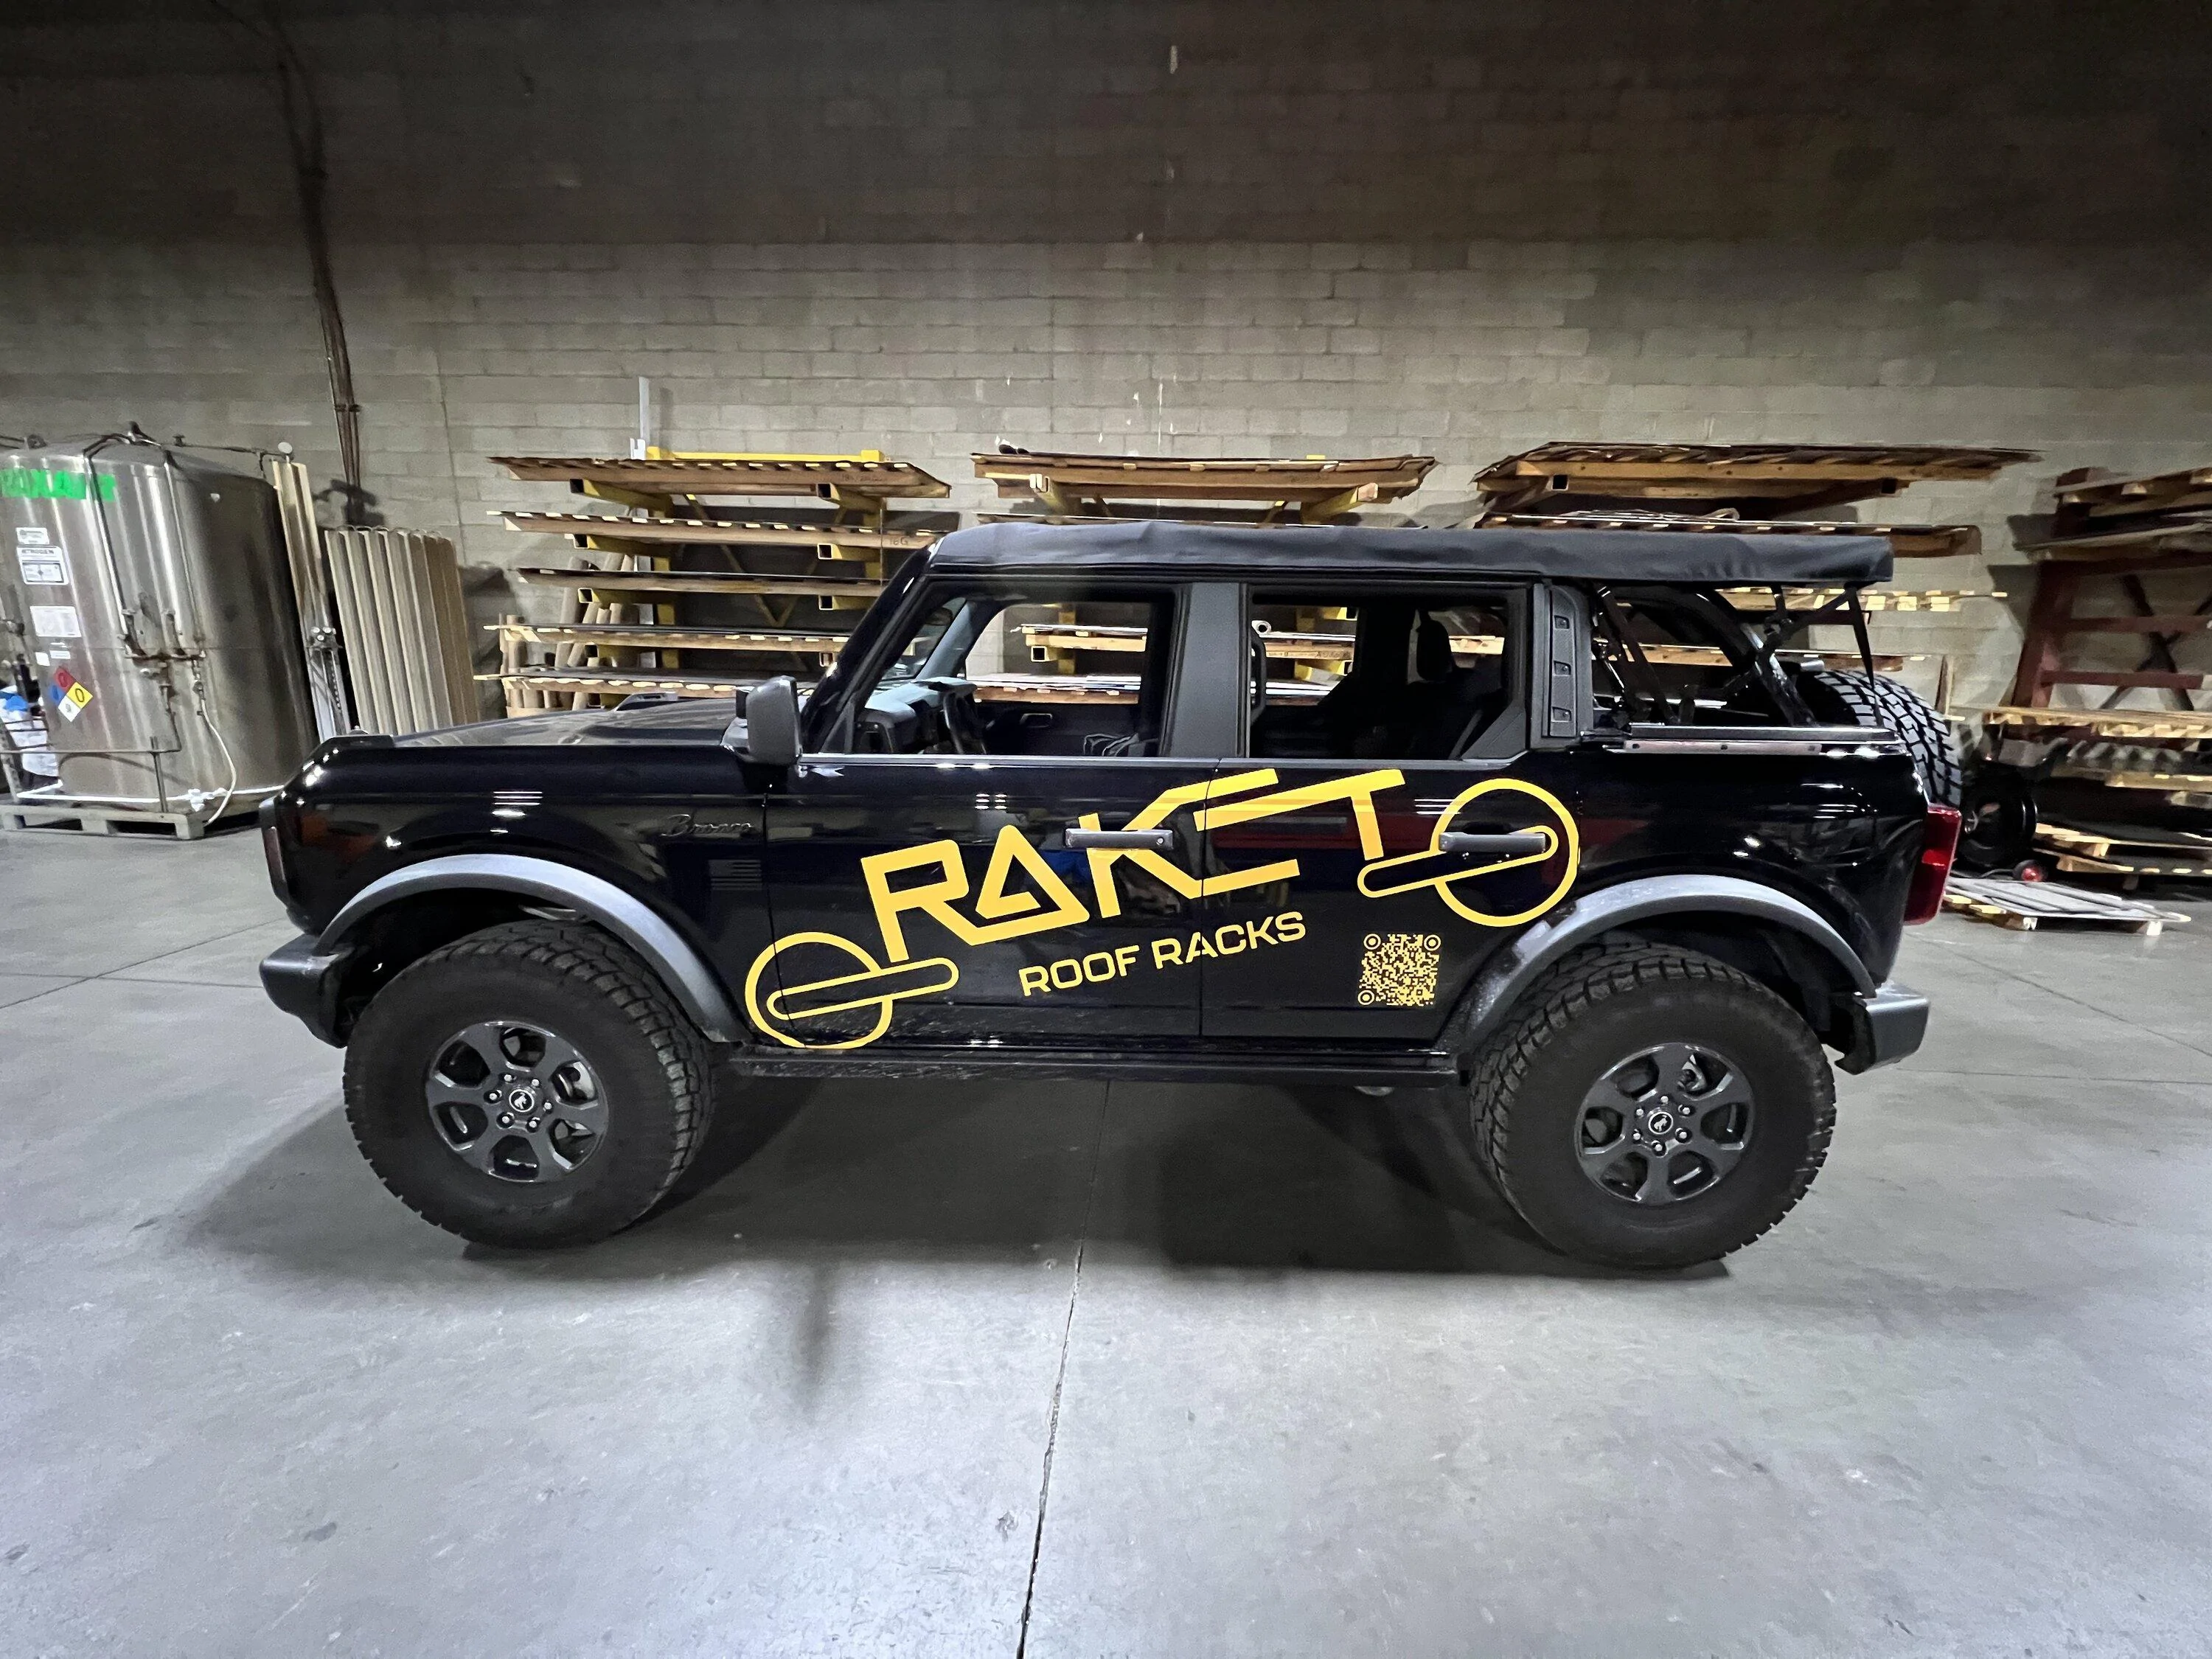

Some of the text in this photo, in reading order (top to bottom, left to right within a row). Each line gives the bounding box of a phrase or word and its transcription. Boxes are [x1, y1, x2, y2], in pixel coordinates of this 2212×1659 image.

[75, 688, 85, 703] 0
[1018, 911, 1306, 997] ROOF RACKS
